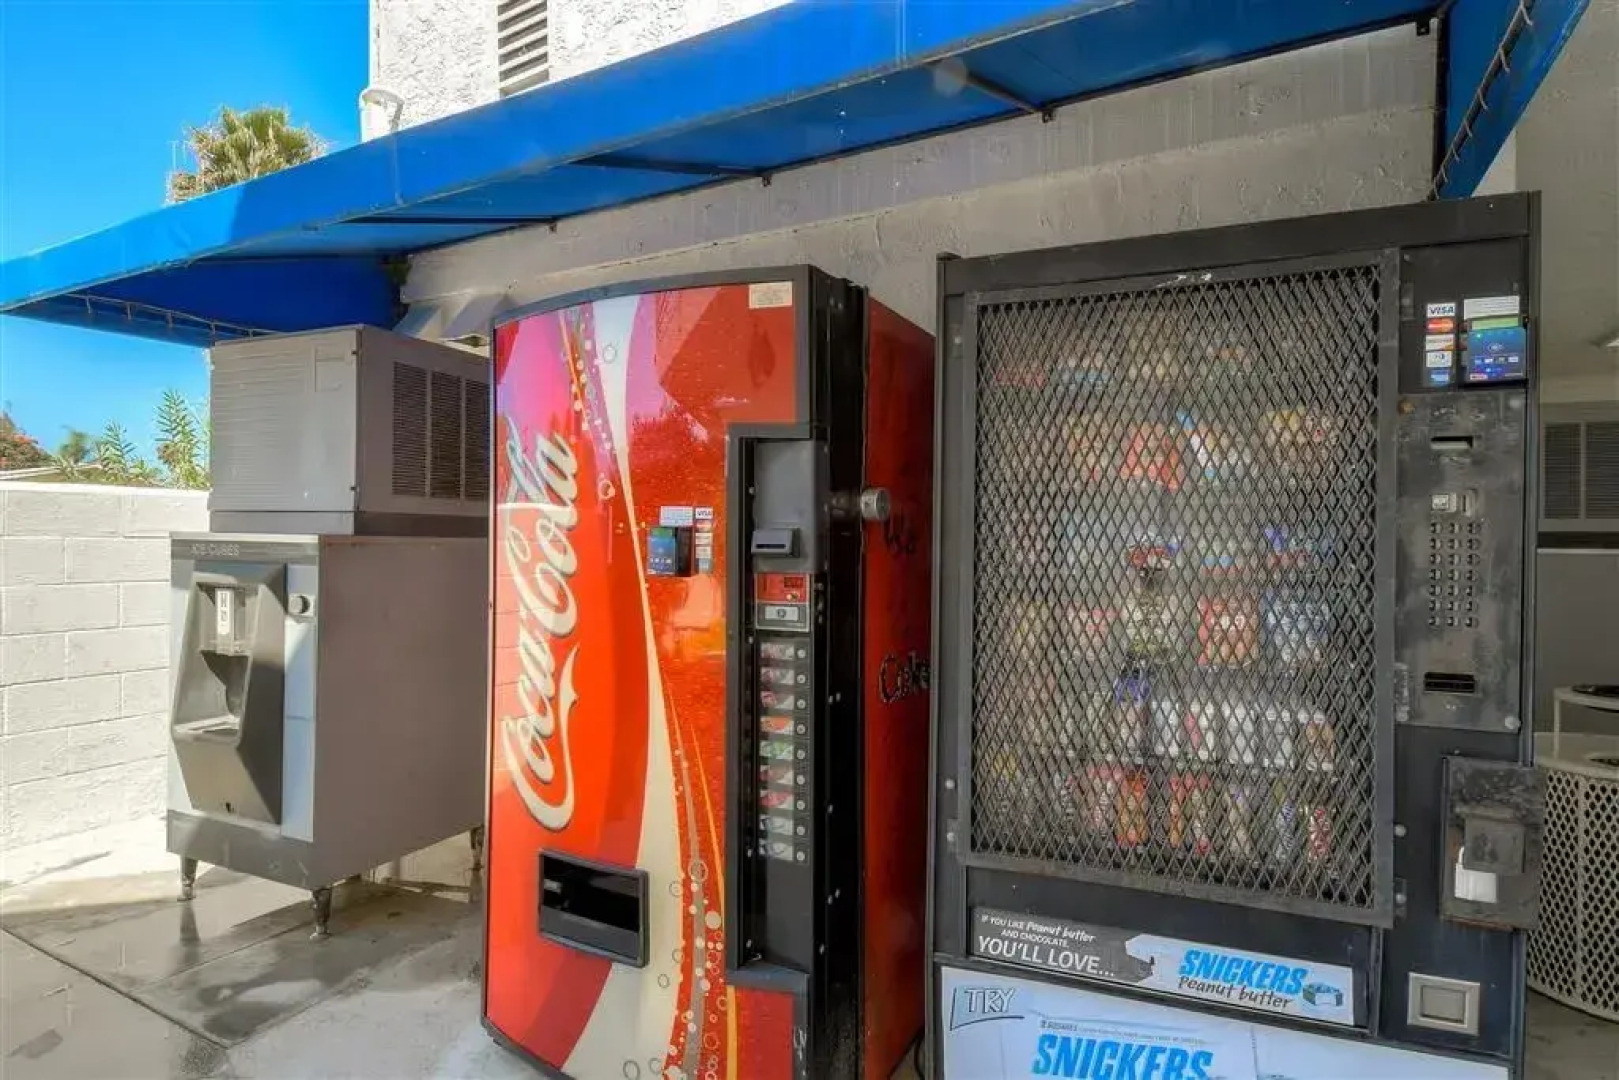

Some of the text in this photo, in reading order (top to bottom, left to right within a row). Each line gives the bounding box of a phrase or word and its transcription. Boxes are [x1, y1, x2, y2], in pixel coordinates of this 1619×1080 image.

[1429, 306, 1454, 314] VISA
[502, 417, 580, 831] Coca-Cola
[990, 917, 1008, 926] YOU
[1008, 919, 1025, 929] LIKE
[1026, 921, 1062, 936] Peanut
[1062, 927, 1097, 943] butter
[1001, 929, 1019, 938] AND
[979, 935, 1115, 977] YOU'LL LOVE...
[1178, 949, 1308, 994] SNICKERS
[964, 987, 1017, 1013] TRY
[1178, 975, 1237, 996] Peanut
[1237, 986, 1295, 1009] butter
[1032, 1033, 1214, 1080] SNICKERS
